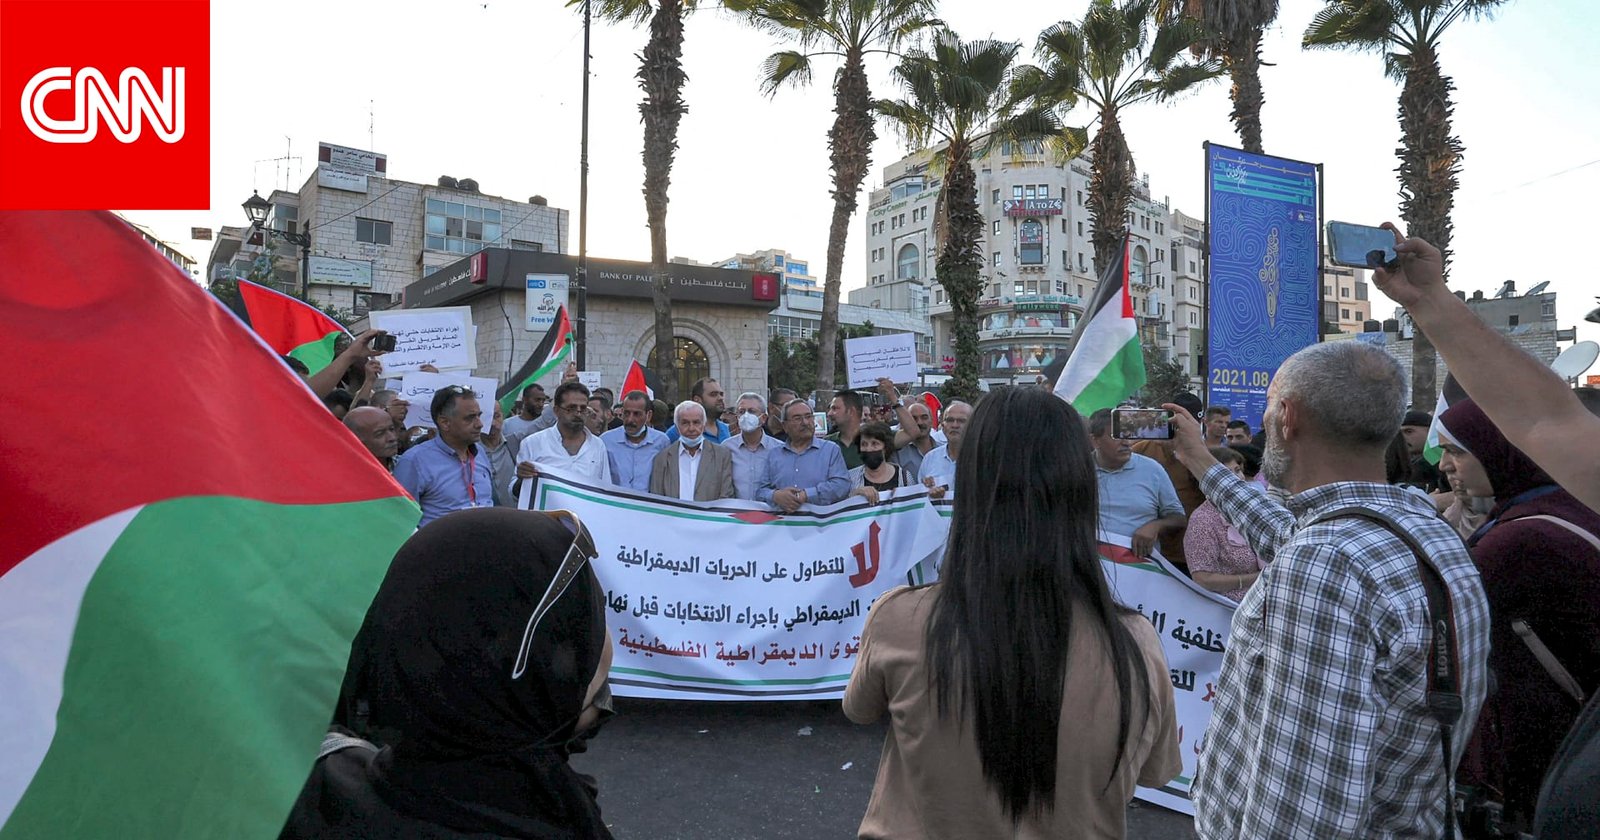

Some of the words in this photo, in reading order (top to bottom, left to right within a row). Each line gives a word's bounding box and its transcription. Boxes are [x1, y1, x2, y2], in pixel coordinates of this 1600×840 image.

[873, 208, 887, 217] City
[887, 200, 908, 212] Center
[1029, 201, 1035, 209] A
[1048, 200, 1055, 209] Z
[600, 271, 620, 280] BANK
[622, 273, 632, 281] OF
[680, 277, 724, 288] فلسطين
[725, 281, 747, 291] بنك
[1212, 368, 1269, 387] 2021.08
[616, 545, 700, 576] الديمقراطية
[849, 520, 881, 589] لا
[705, 558, 757, 581] الحريات
[762, 562, 788, 583] على
[793, 556, 844, 583] للتطاول
[633, 595, 659, 618] قبل
[664, 601, 731, 625] الانتخابات
[736, 606, 779, 629] باجراء
[783, 599, 860, 632] الديمقراطي
[619, 627, 707, 659] الفلسطينية
[715, 641, 823, 667] الديمقراطية
[1436, 619, 1448, 677] Canon
